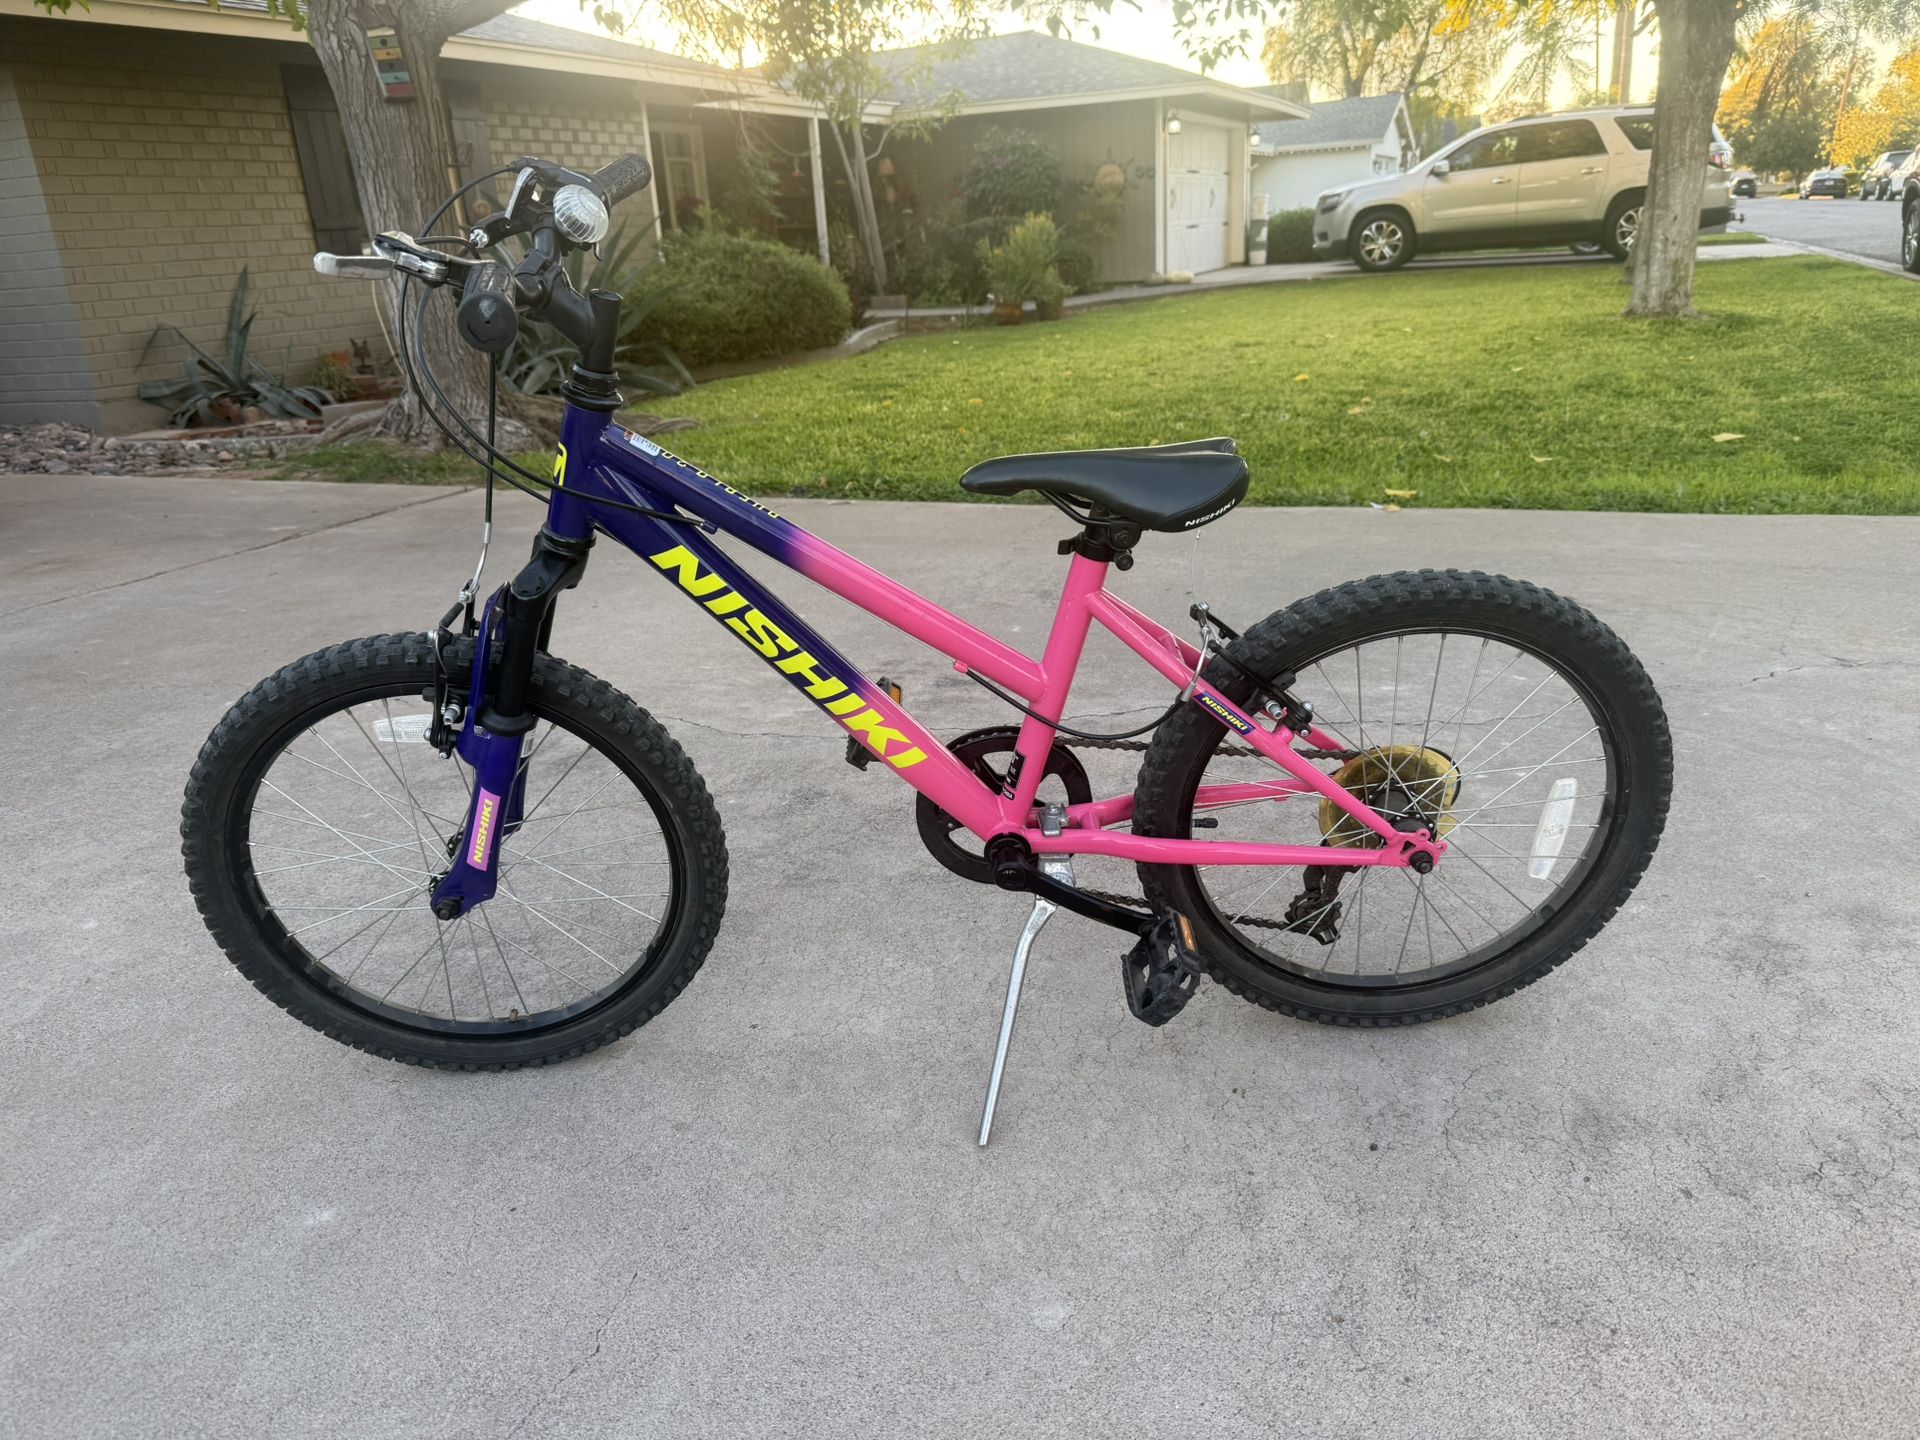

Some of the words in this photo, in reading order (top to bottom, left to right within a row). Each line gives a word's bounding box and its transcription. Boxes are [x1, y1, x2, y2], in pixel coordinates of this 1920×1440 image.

[1185, 498, 1235, 527] NISHIKI
[649, 545, 928, 768] NISHIKI
[1202, 696, 1248, 730] NISHIKI
[473, 798, 493, 864] NISHIKI
